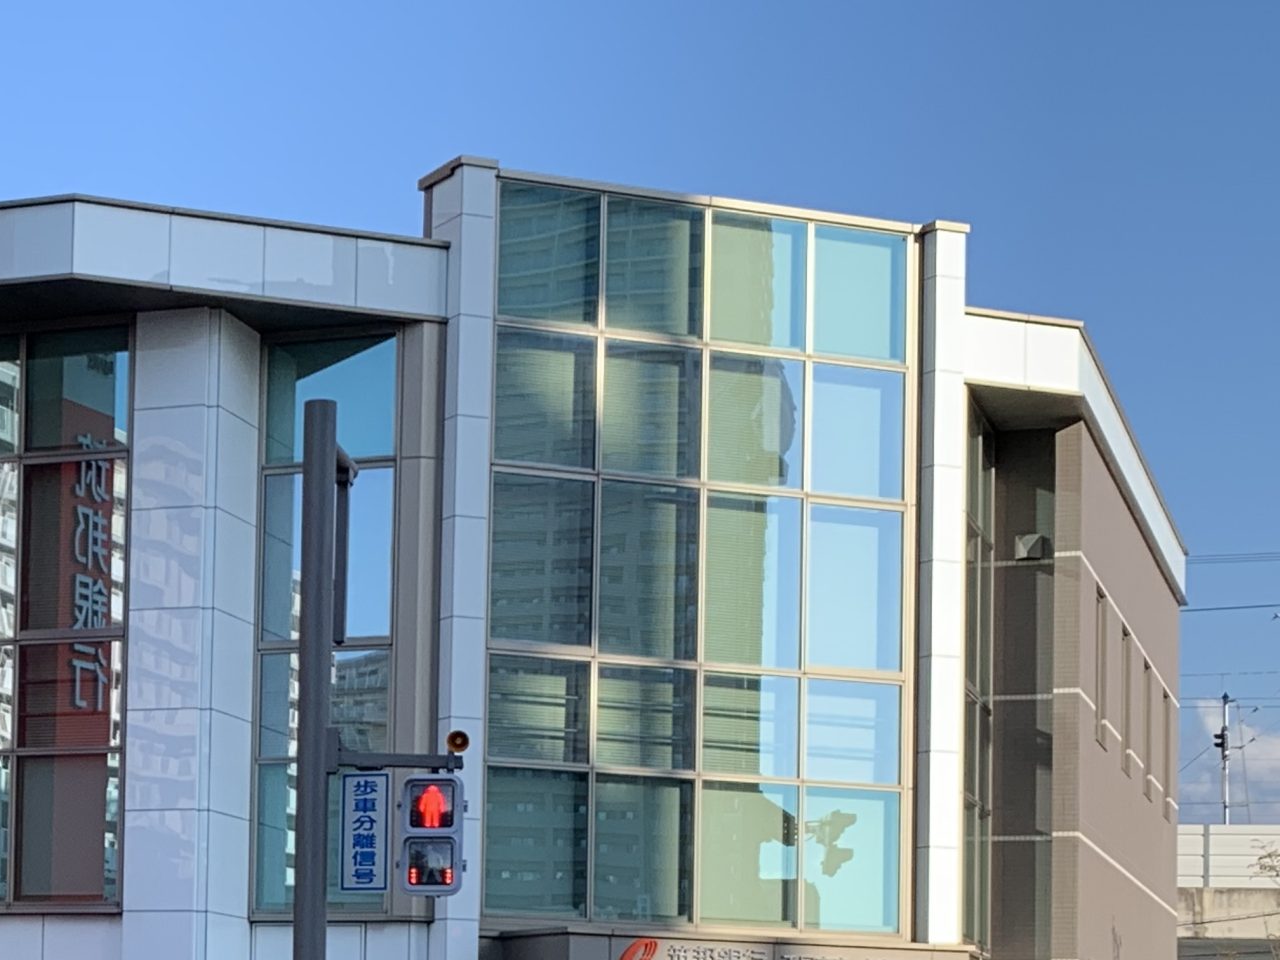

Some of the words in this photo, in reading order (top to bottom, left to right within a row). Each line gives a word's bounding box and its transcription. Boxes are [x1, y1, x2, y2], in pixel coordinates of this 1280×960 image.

[352, 780, 378, 884] 歩車分離信号
